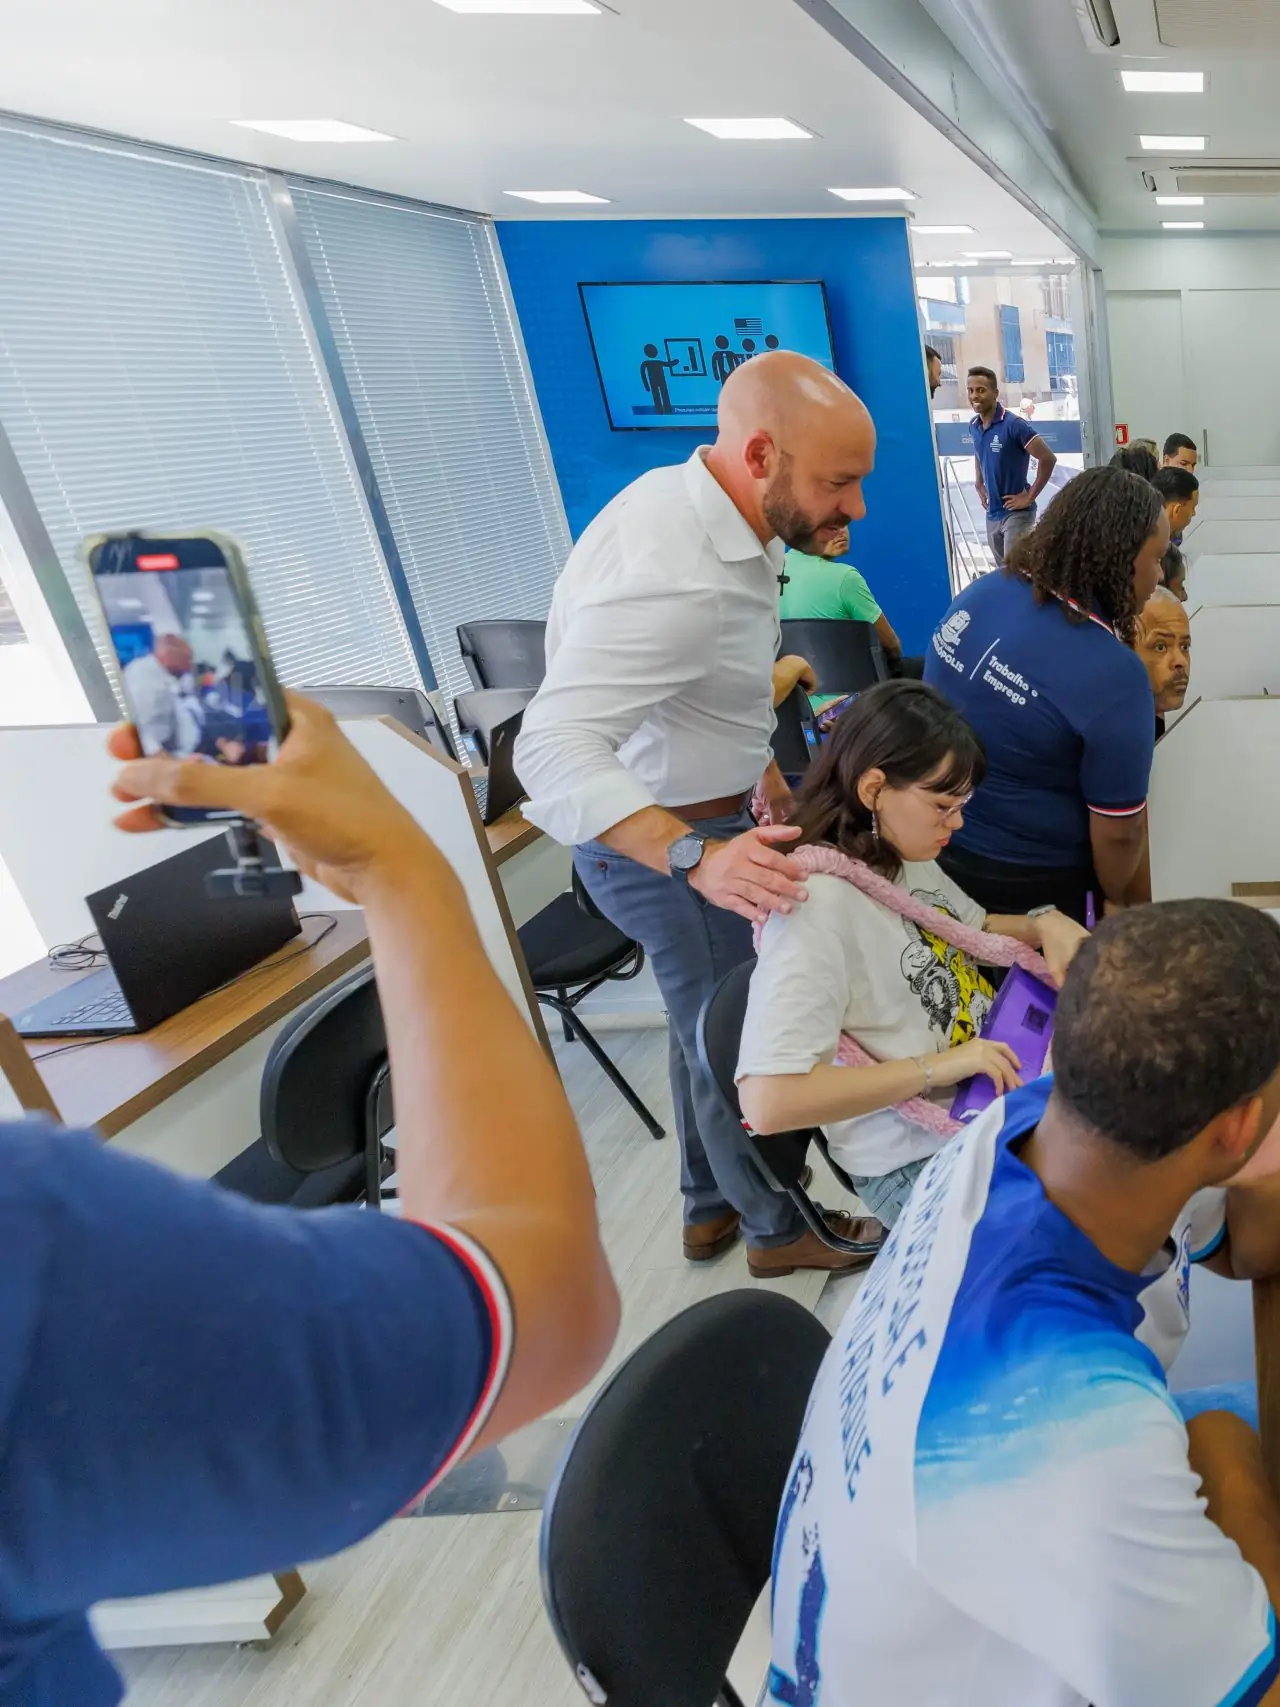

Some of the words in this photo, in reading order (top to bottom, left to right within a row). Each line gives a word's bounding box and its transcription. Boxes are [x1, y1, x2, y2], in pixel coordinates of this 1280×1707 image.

[932, 632, 965, 673] ÓPOLIS
[982, 670, 1027, 706] Emprego
[988, 655, 1030, 692] Trabalho
